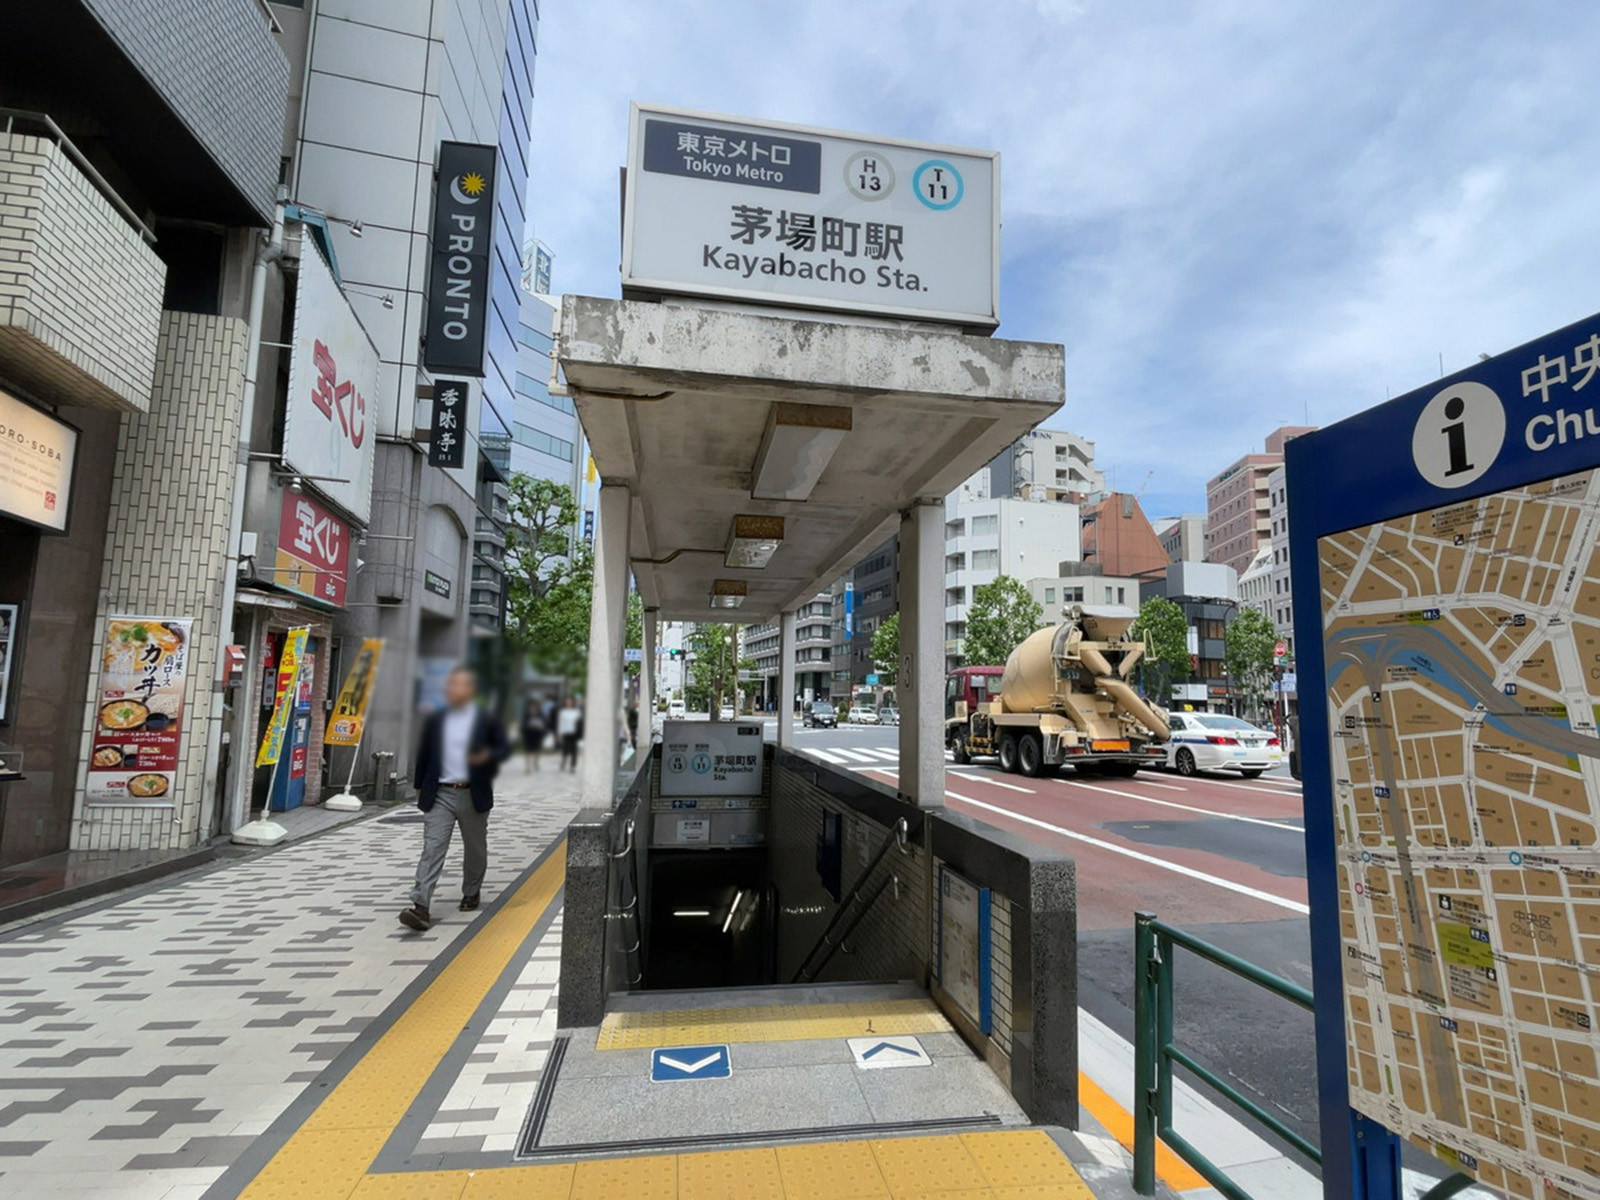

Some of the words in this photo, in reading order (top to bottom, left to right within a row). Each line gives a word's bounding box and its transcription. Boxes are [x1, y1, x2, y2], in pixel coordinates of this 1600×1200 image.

[677, 131, 791, 166] 東京メトロ
[683, 155, 732, 176] Tokyo
[735, 160, 784, 183] Metro
[863, 158, 877, 174] H
[933, 168, 944, 182] T
[859, 174, 882, 192] 13
[928, 183, 948, 200] 11
[730, 204, 904, 262] 茅場町駅
[443, 213, 476, 341] PRONTO
[703, 244, 866, 286] Kayabacho
[876, 265, 929, 292] Sta.
[311, 339, 365, 449] 宝くじ
[294, 500, 340, 565] 宝くじ
[714, 755, 757, 766] 茅場町駅
[1513, 909, 1552, 930] 中央区
